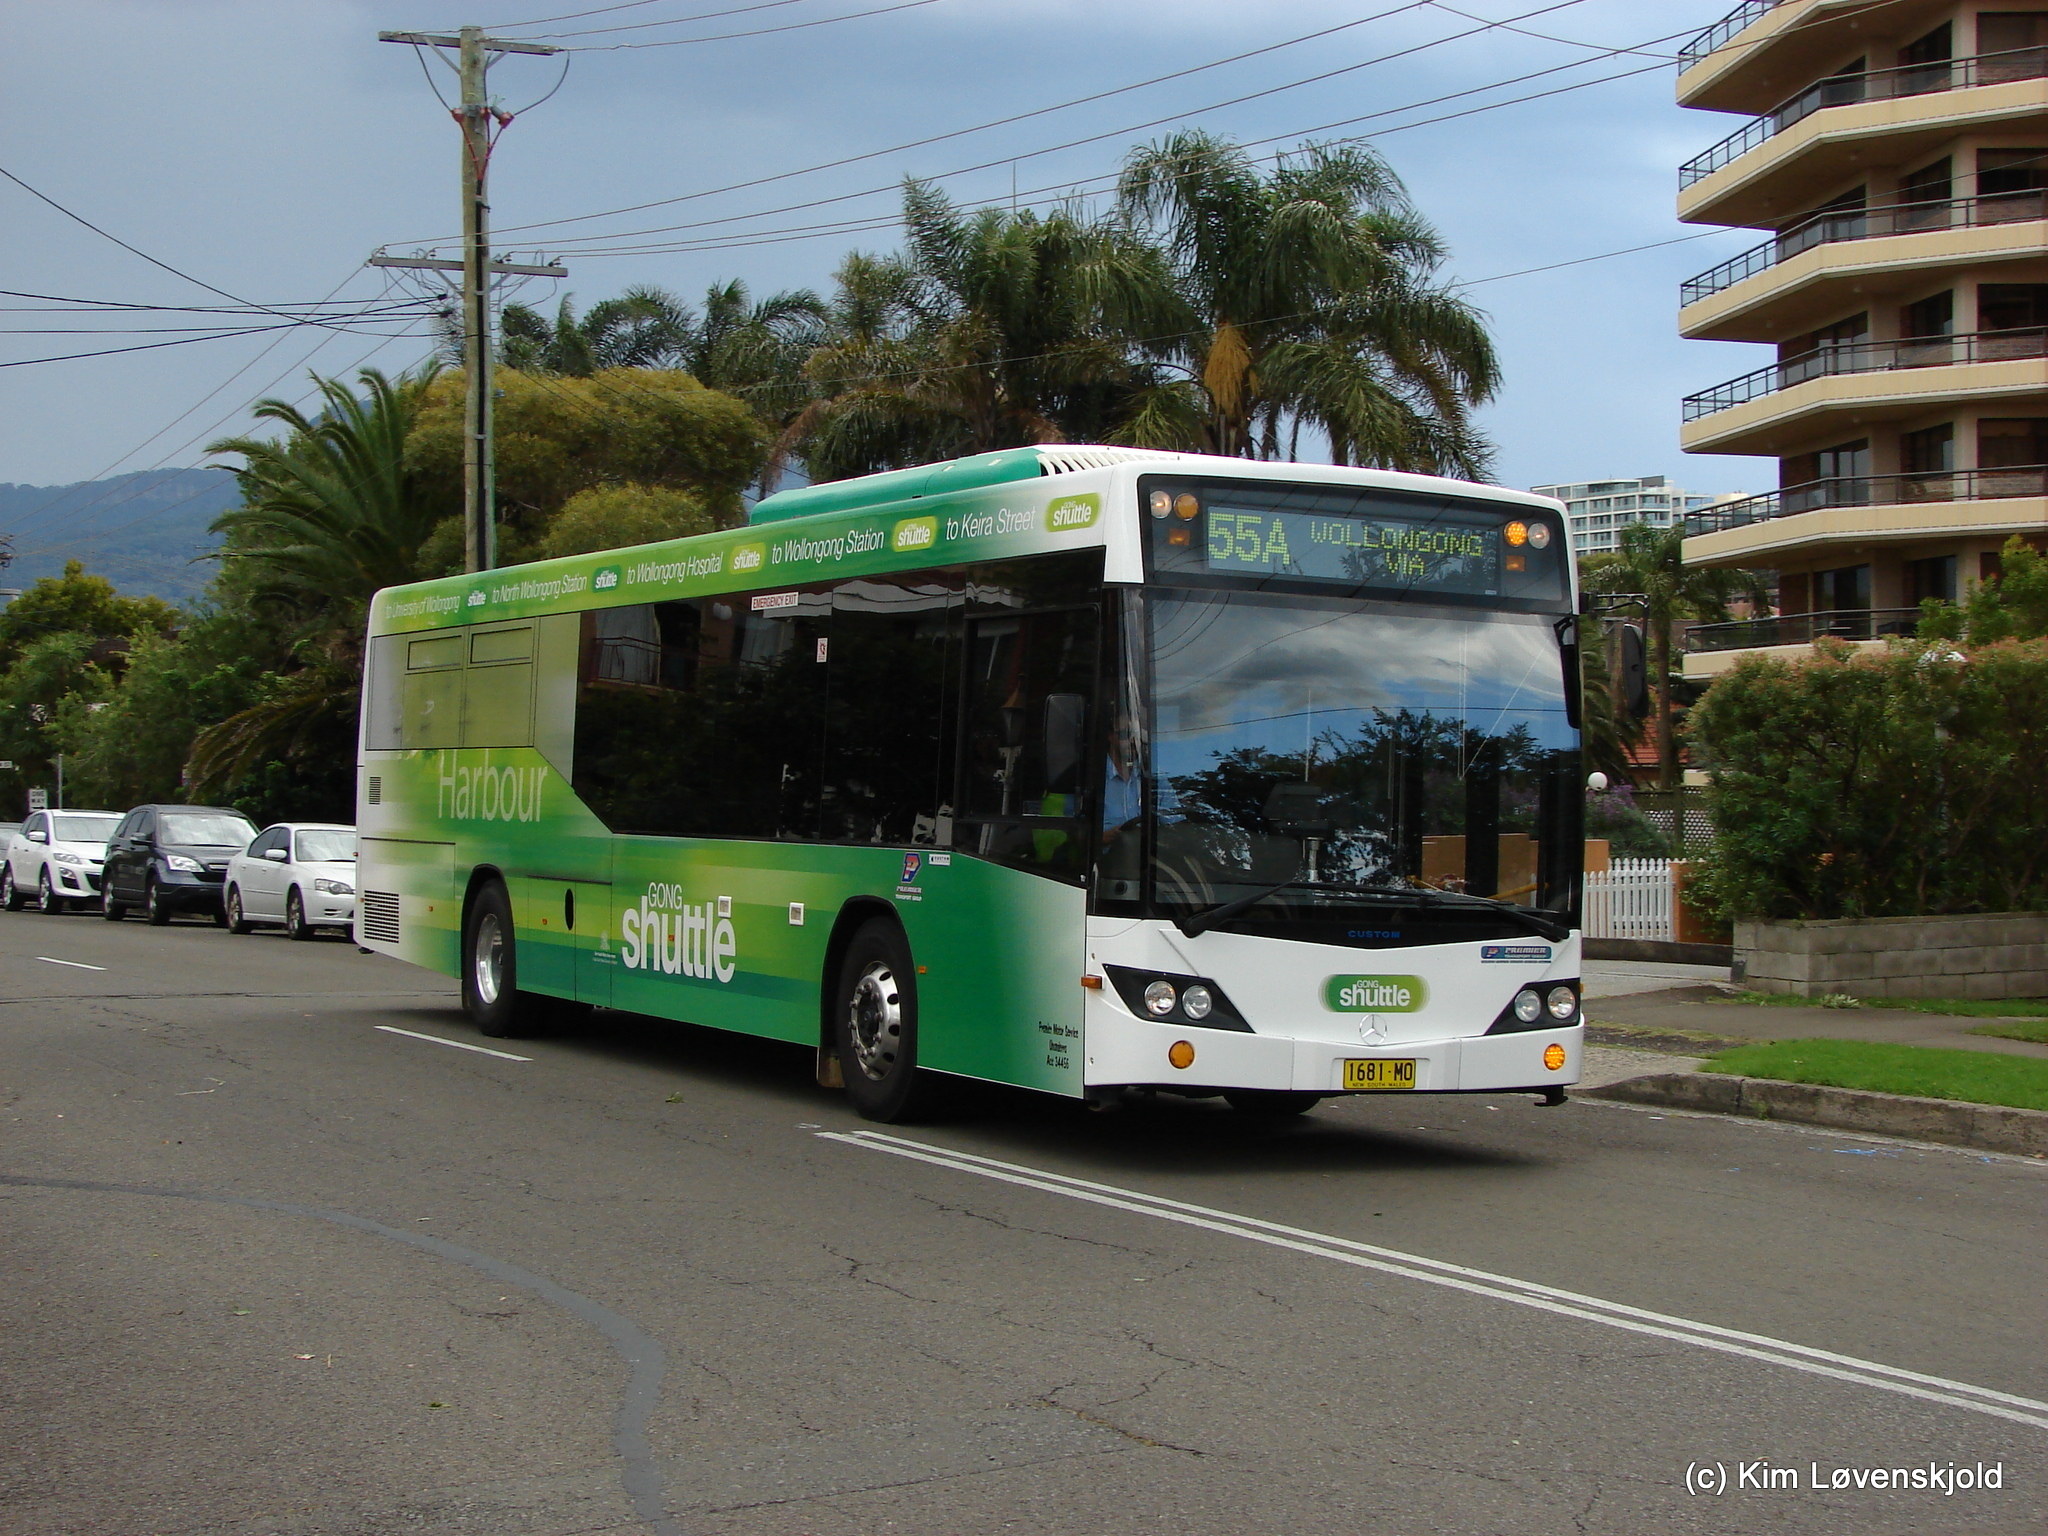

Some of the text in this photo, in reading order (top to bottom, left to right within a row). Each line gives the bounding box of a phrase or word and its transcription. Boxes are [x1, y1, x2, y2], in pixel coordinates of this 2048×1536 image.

[946, 506, 1036, 541] to Keira Street
[1052, 502, 1092, 527] shuttle
[771, 528, 885, 565] to Wollongong Station
[897, 525, 930, 548] shuttle
[1208, 512, 1291, 566] 55A
[1310, 520, 1484, 557] WOLLONGONG
[626, 551, 724, 585] to Wollongong Hospital
[733, 549, 761, 571] shuttle
[1385, 551, 1425, 576] VIA
[491, 573, 588, 604] to North Wollongong Station
[595, 571, 618, 589] shuttle
[753, 593, 798, 609] EMERGENCY EXIT
[438, 749, 548, 822] Harbour
[648, 881, 683, 910] GONG
[621, 895, 737, 984] shuttle
[1347, 930, 1401, 938] CUSTOM
[1339, 984, 1411, 1007] shuttle
[1356, 980, 1379, 988] GONG
